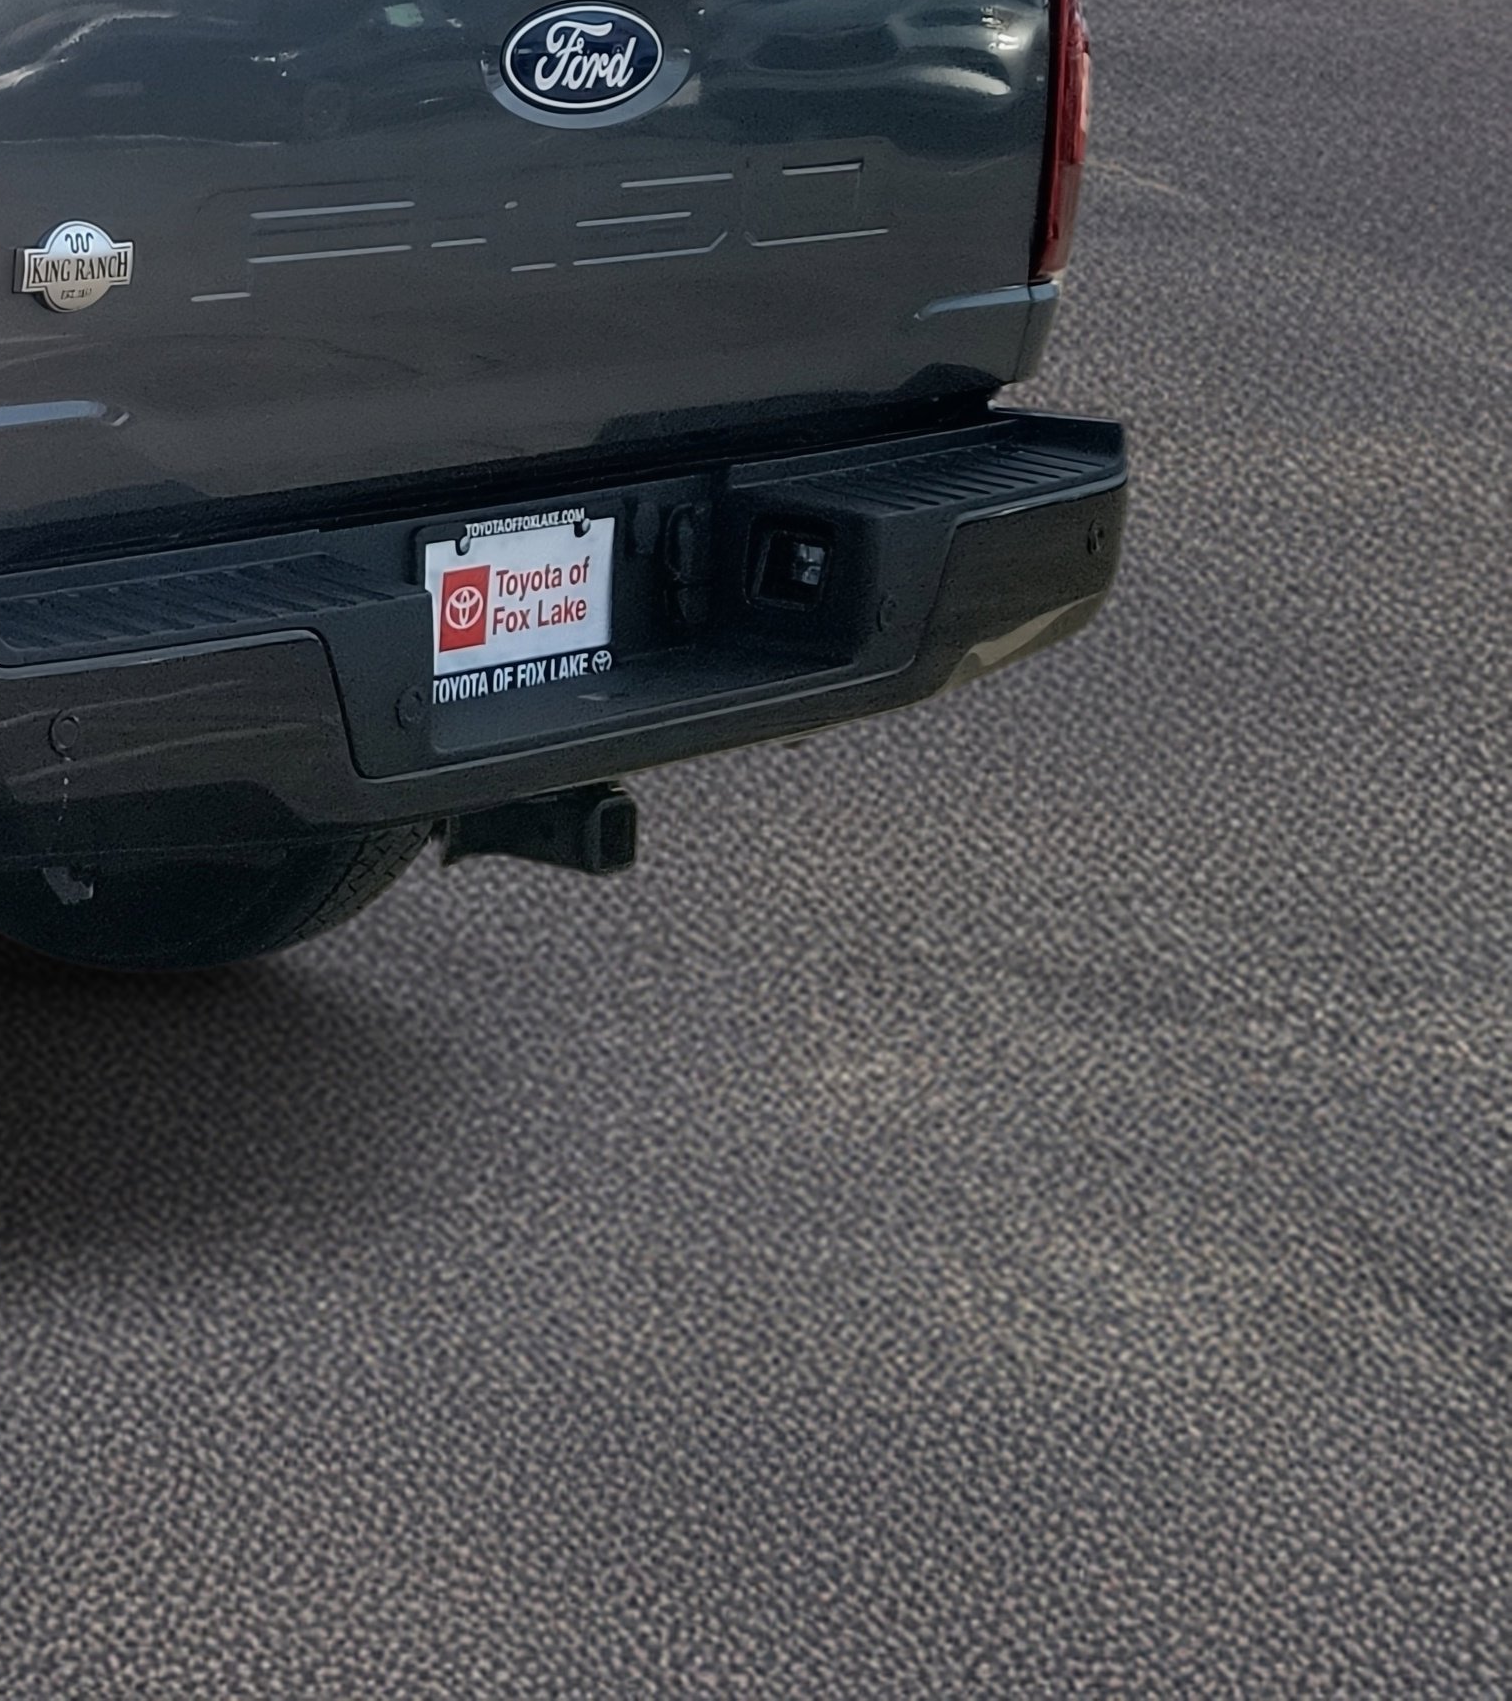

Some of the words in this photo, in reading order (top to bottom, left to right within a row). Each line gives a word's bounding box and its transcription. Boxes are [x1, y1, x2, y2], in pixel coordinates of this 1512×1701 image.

[534, 20, 637, 91] Ford
[31, 257, 72, 284] KING
[75, 251, 129, 281] RANCH
[496, 563, 562, 602] Toyota
[569, 555, 590, 586] of
[492, 606, 531, 636] Fox
[537, 595, 587, 629] Lake
[433, 671, 489, 705] TOYOTA
[493, 666, 514, 693] OF
[517, 660, 548, 689] FOX
[550, 653, 589, 681] LAKE
